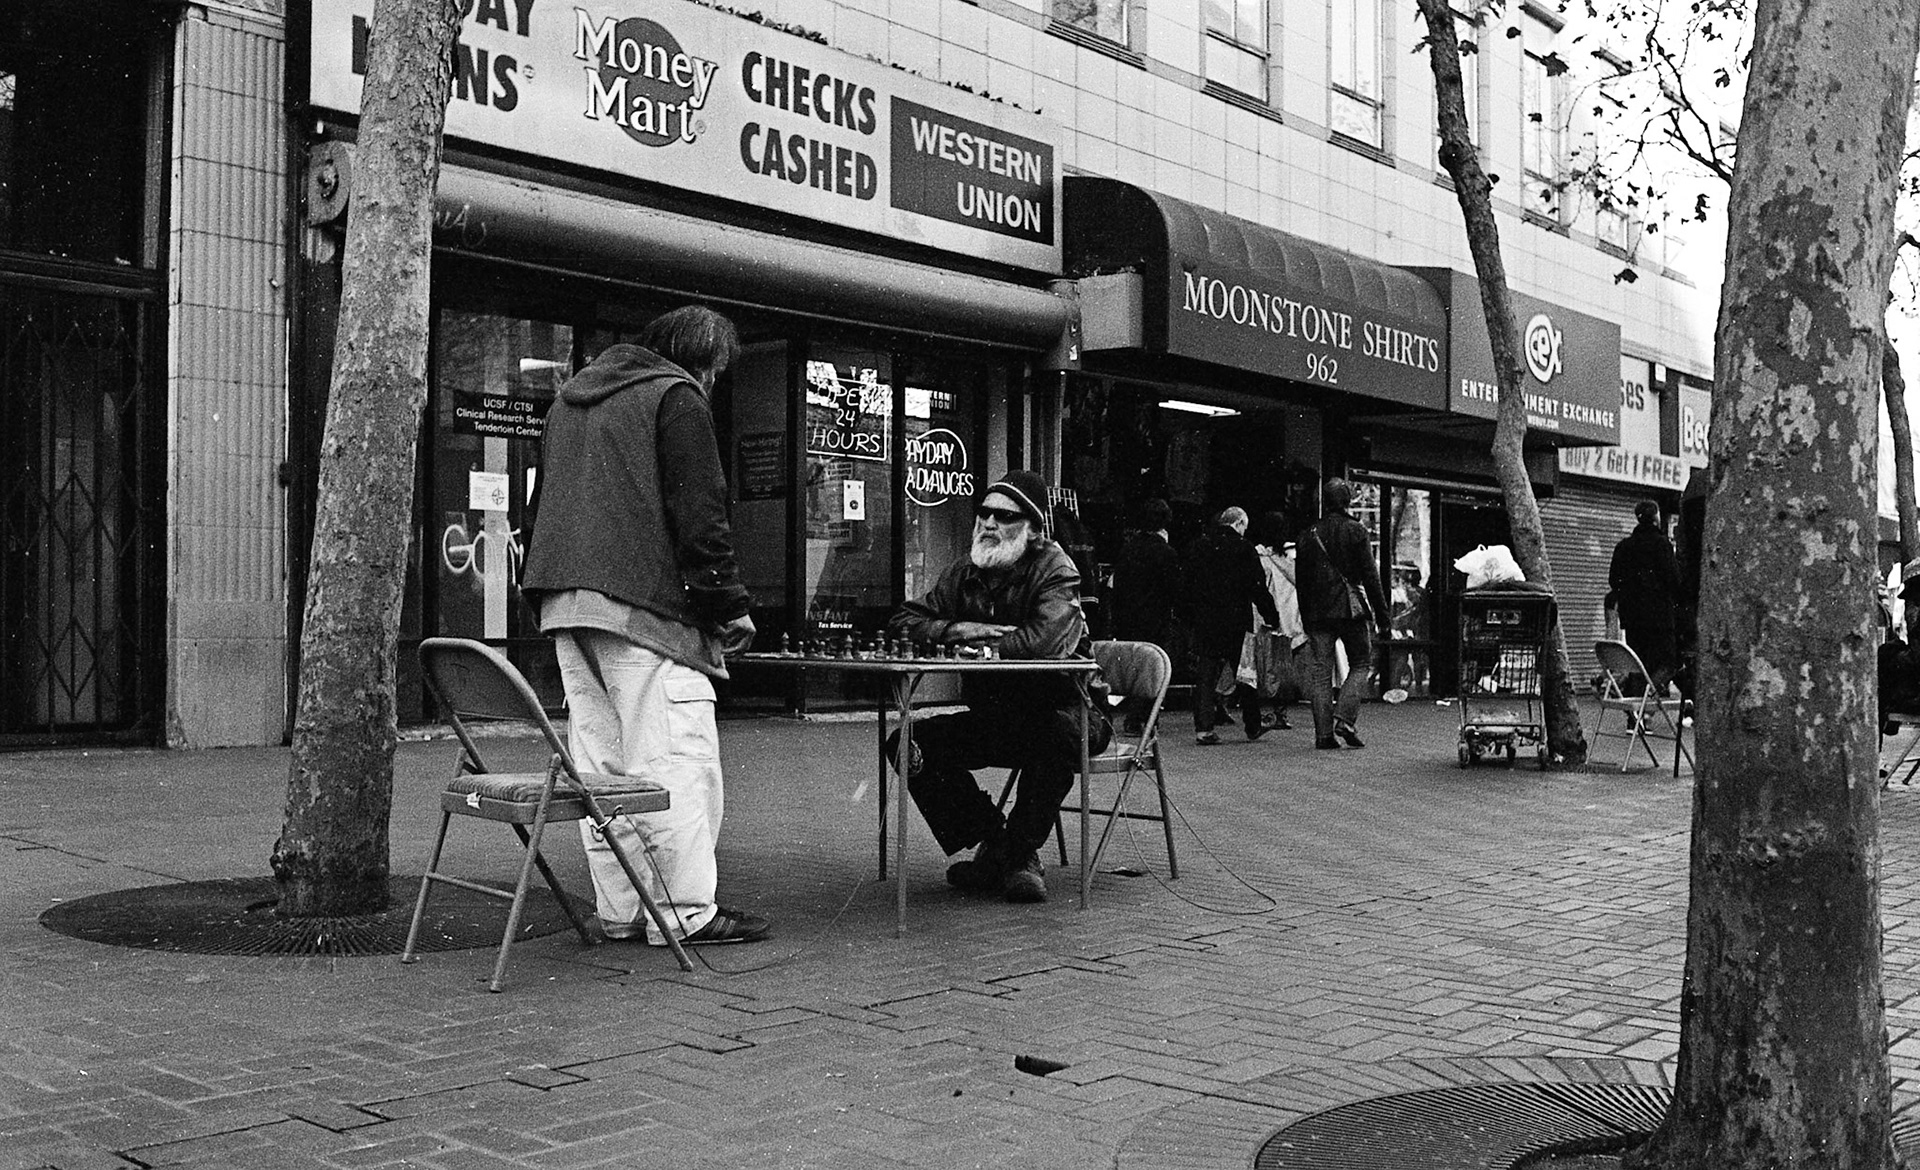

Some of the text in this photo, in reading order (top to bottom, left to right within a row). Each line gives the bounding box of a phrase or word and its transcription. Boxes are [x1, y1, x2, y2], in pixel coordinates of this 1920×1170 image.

[573, 7, 718, 109] Money
[584, 66, 696, 144] Mart
[742, 51, 876, 135] CHECKS
[740, 122, 877, 201] CASHED
[910, 116, 1041, 185] WESTERN
[957, 182, 1041, 233] UNION
[1183, 272, 1438, 372] MOONSTONE SHIRTS
[1306, 352, 1338, 384] 962
[456, 407, 486, 419] Clinical
[488, 410, 524, 423] Research
[483, 398, 507, 409] UCSF
[514, 401, 534, 412] CTSI
[836, 408, 855, 427] 24
[1563, 402, 1614, 428] EXCHANGE
[474, 421, 542, 437] Tenderloin Center
[811, 428, 881, 453] HOURS
[905, 466, 974, 496] ADVANCES
[1595, 448, 1603, 473] 2
[1607, 449, 1628, 475] Get
[1642, 455, 1682, 486] FREE
